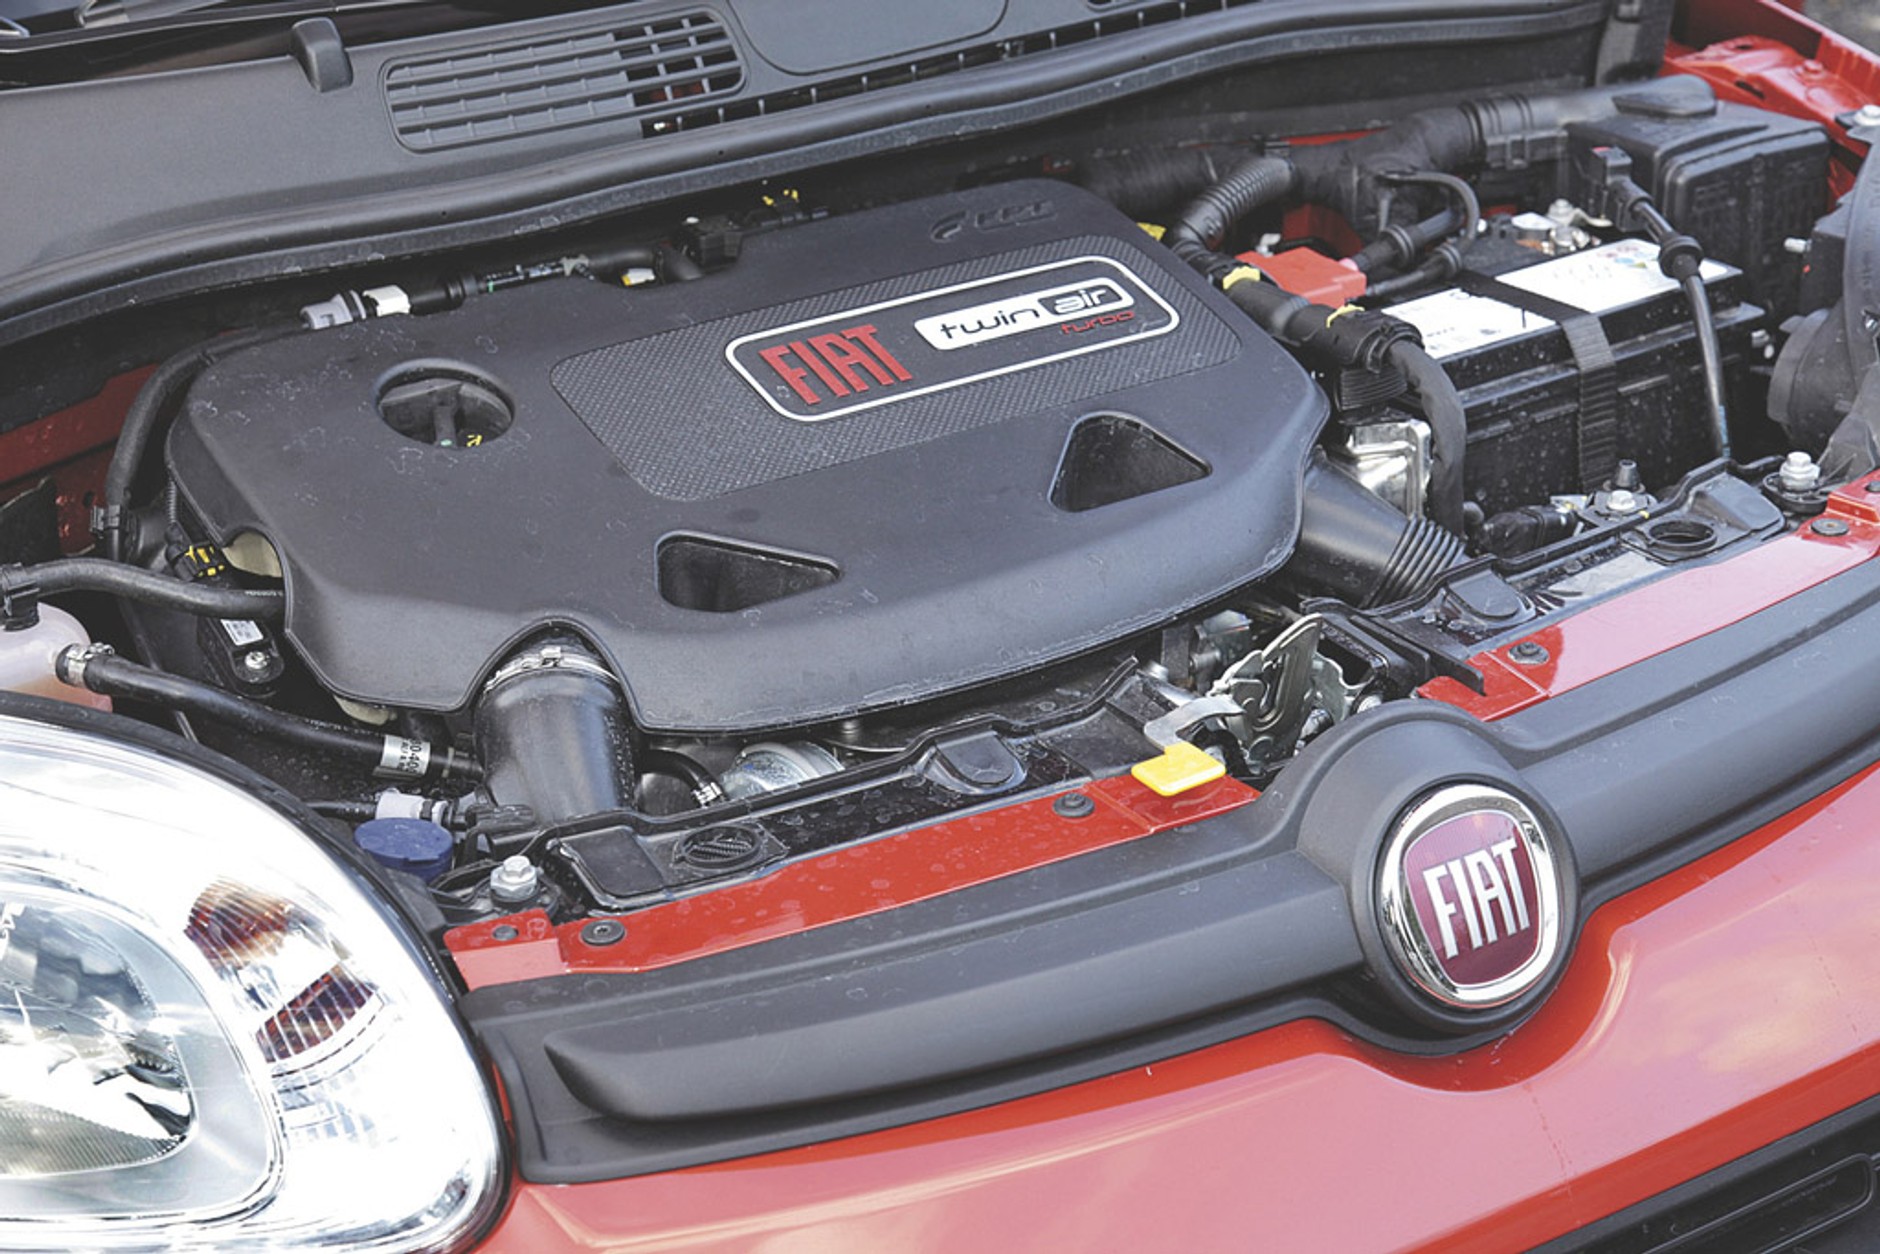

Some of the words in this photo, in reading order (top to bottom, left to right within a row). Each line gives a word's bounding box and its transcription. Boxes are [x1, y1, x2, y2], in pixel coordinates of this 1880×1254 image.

[940, 307, 1040, 339] twin
[1054, 288, 1107, 314] air
[1060, 310, 1135, 335] turbo
[759, 323, 913, 405] FIAT
[1422, 834, 1531, 960] FIAT
